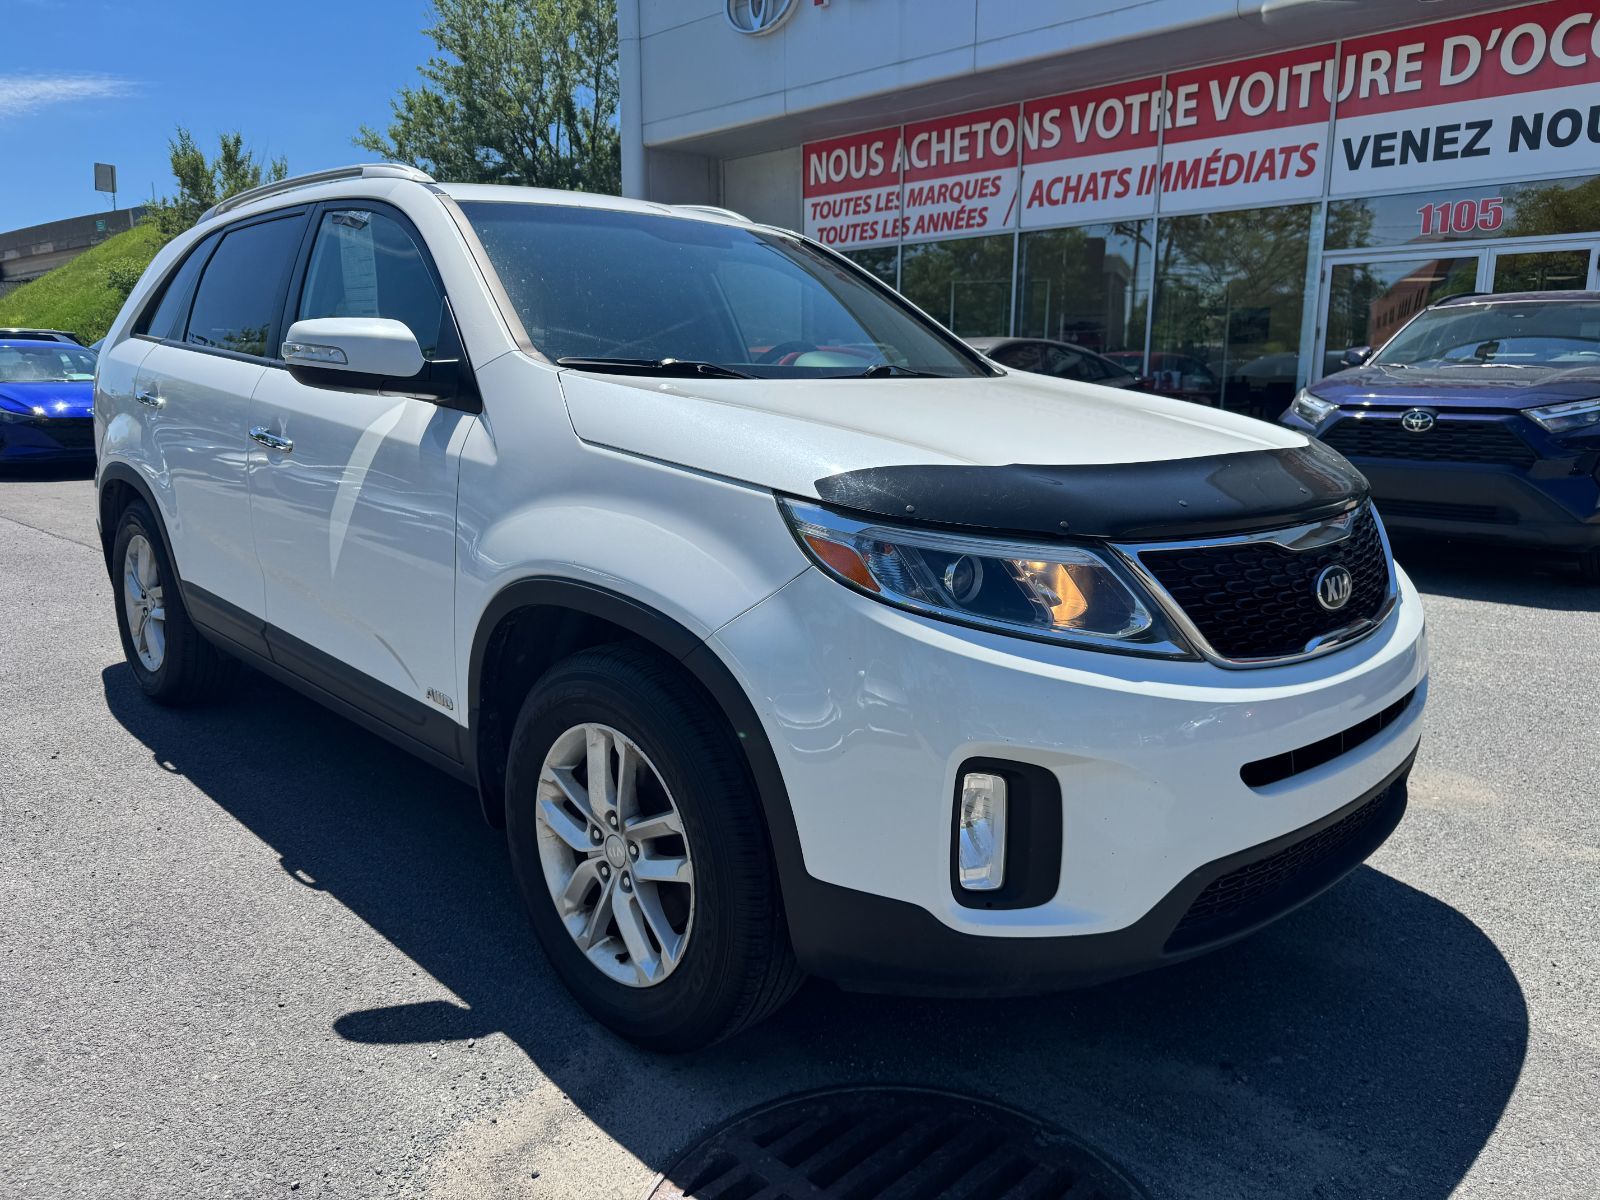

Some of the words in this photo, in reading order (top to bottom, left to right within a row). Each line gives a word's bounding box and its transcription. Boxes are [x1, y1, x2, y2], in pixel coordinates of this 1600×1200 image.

[809, 141, 885, 187] NOUS
[890, 108, 1062, 174] ACHETONS
[1069, 82, 1199, 144] VOTRE
[1208, 41, 1425, 122] VOITURE
[1439, 12, 1600, 87] D'OC
[1342, 119, 1494, 171] VENEZ
[810, 191, 872, 221] TOUTES
[874, 190, 902, 213] LES
[906, 175, 1002, 209] MARQUES
[1026, 166, 1133, 209] ACHATS
[1136, 142, 1320, 197] IMMÉDIATS
[817, 220, 879, 246] TOUTES
[881, 216, 910, 239] LES
[912, 205, 989, 235] ANNÉES
[1416, 196, 1504, 236] 1105
[1324, 573, 1351, 603] KIA
